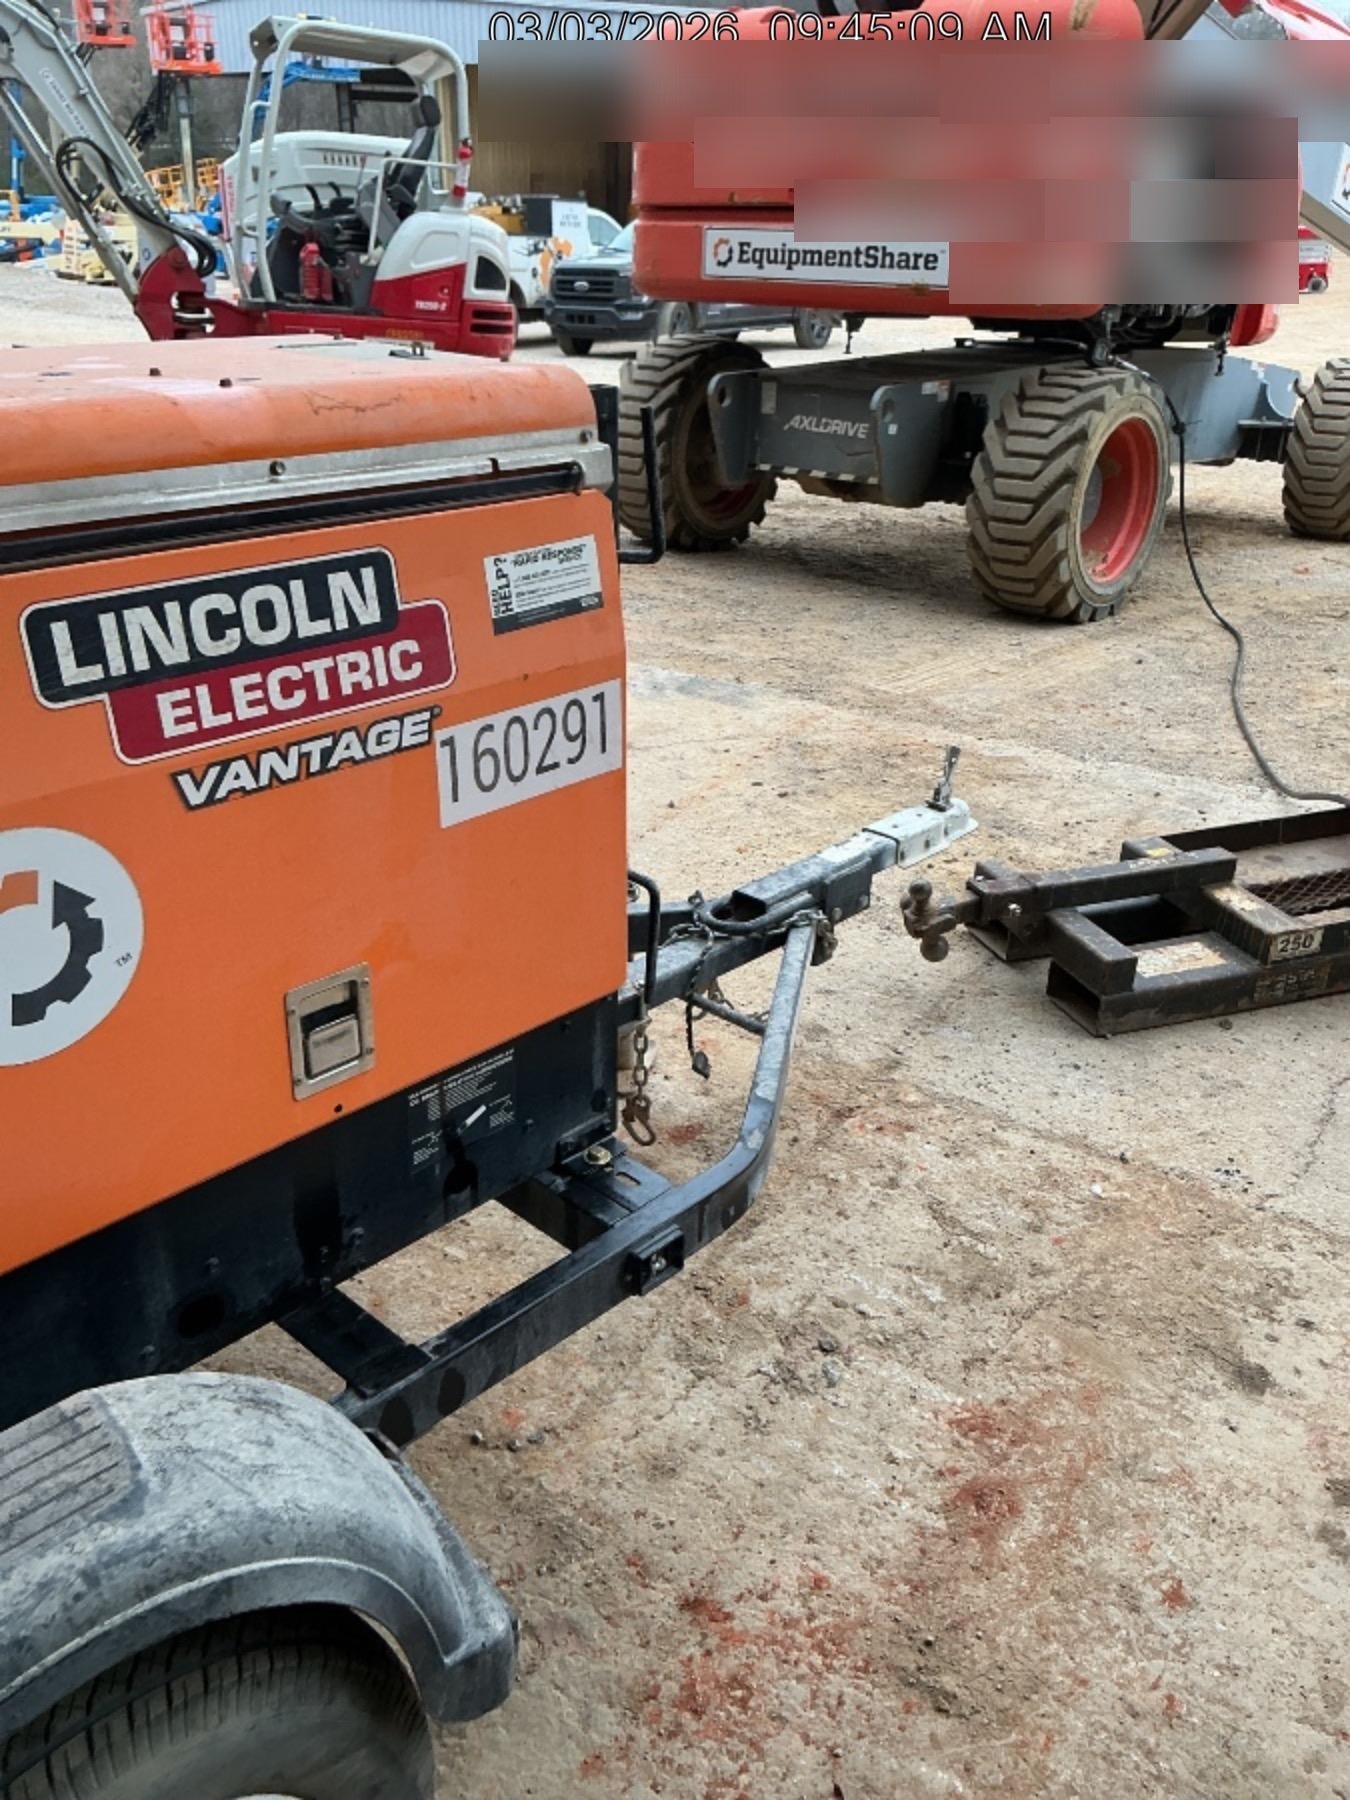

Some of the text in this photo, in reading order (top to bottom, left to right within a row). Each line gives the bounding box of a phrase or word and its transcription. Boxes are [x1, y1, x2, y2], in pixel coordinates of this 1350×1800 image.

[737, 241, 940, 272] EquipmentShare
[48, 565, 382, 688] LINCOLN
[494, 557, 515, 615] HELP?
[155, 638, 424, 740] ELECTRIC
[174, 709, 433, 809] VANTAGE
[439, 691, 609, 804] 160291
